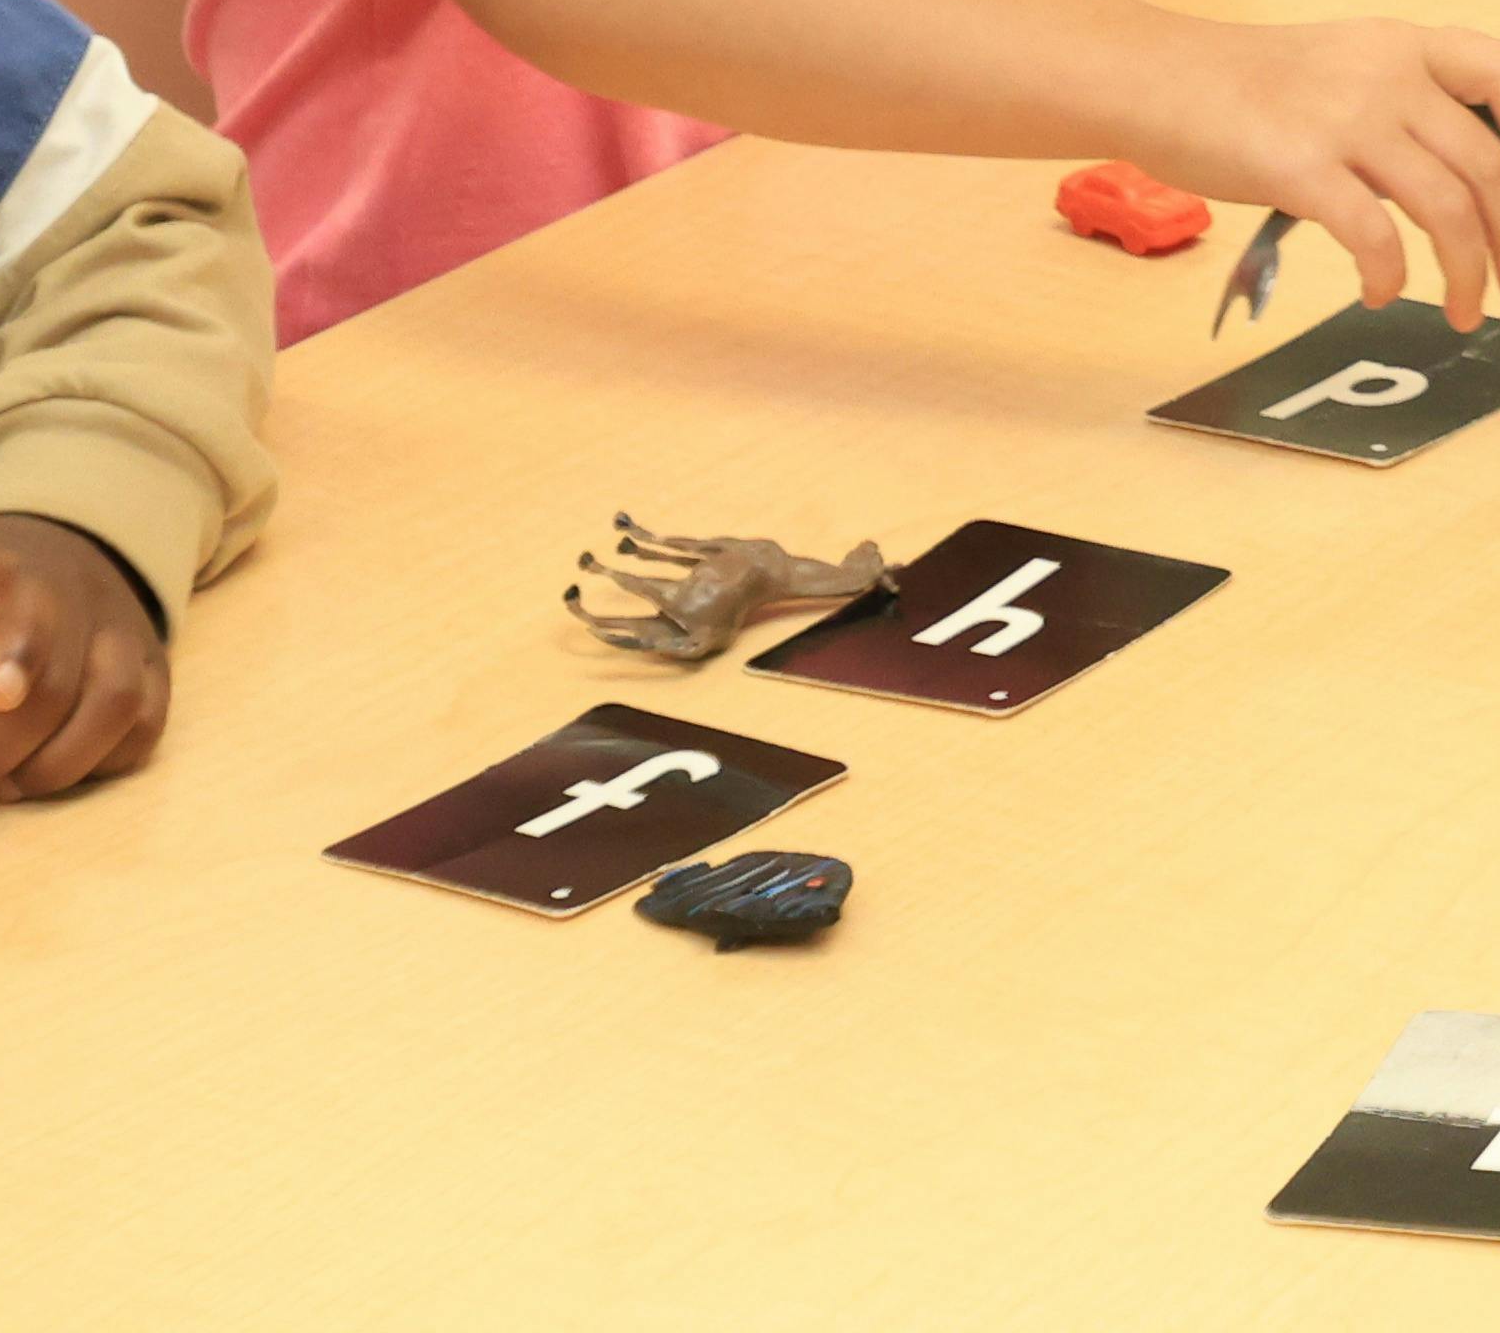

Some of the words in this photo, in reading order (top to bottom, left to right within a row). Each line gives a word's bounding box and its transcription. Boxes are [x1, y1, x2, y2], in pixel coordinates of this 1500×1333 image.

[1259, 358, 1428, 421] p
[910, 556, 1062, 657] h
[514, 749, 723, 837] f
